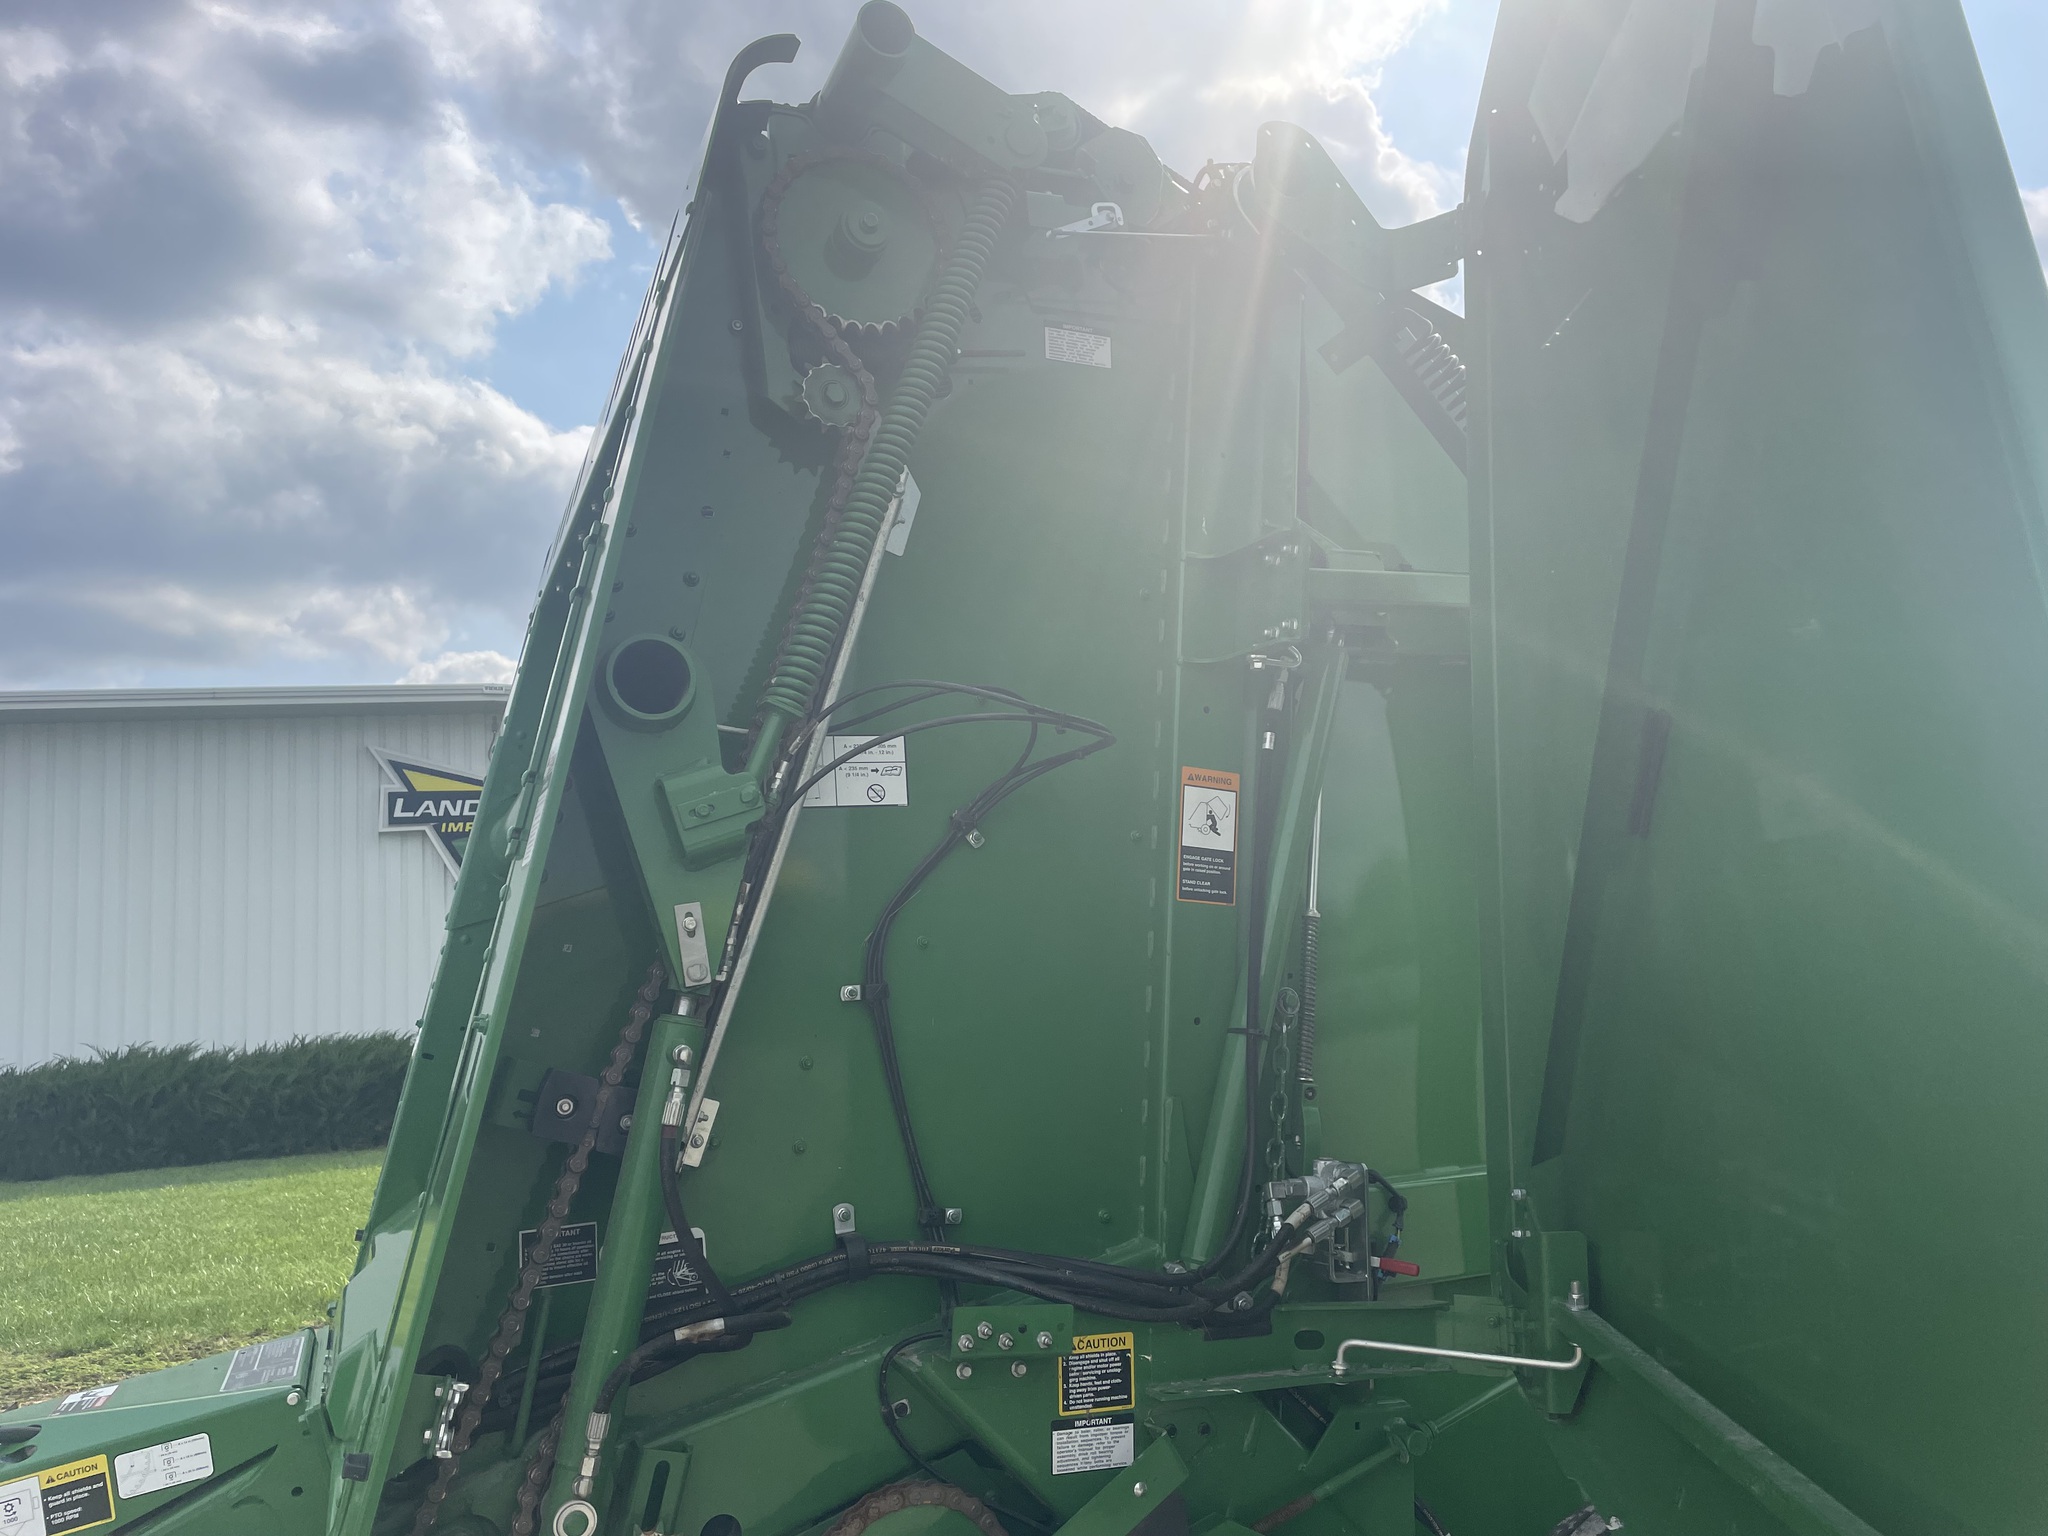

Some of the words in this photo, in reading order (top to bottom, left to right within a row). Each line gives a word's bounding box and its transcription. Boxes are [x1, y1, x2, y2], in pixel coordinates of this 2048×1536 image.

[1194, 773, 1232, 786] WARNING
[1077, 1336, 1126, 1350] CAUTION
[1074, 1417, 1113, 1427] IMPORTANT
[56, 1463, 98, 1481] CAUTION
[48, 1494, 63, 1502] Keep
[71, 1485, 92, 1497] shields
[92, 1481, 104, 1489] and
[48, 1499, 65, 1509] guard
[72, 1493, 90, 1502] place.
[3, 1516, 18, 1524] 1000
[50, 1512, 63, 1520] PTO
[65, 1513, 79, 1521] RPM
